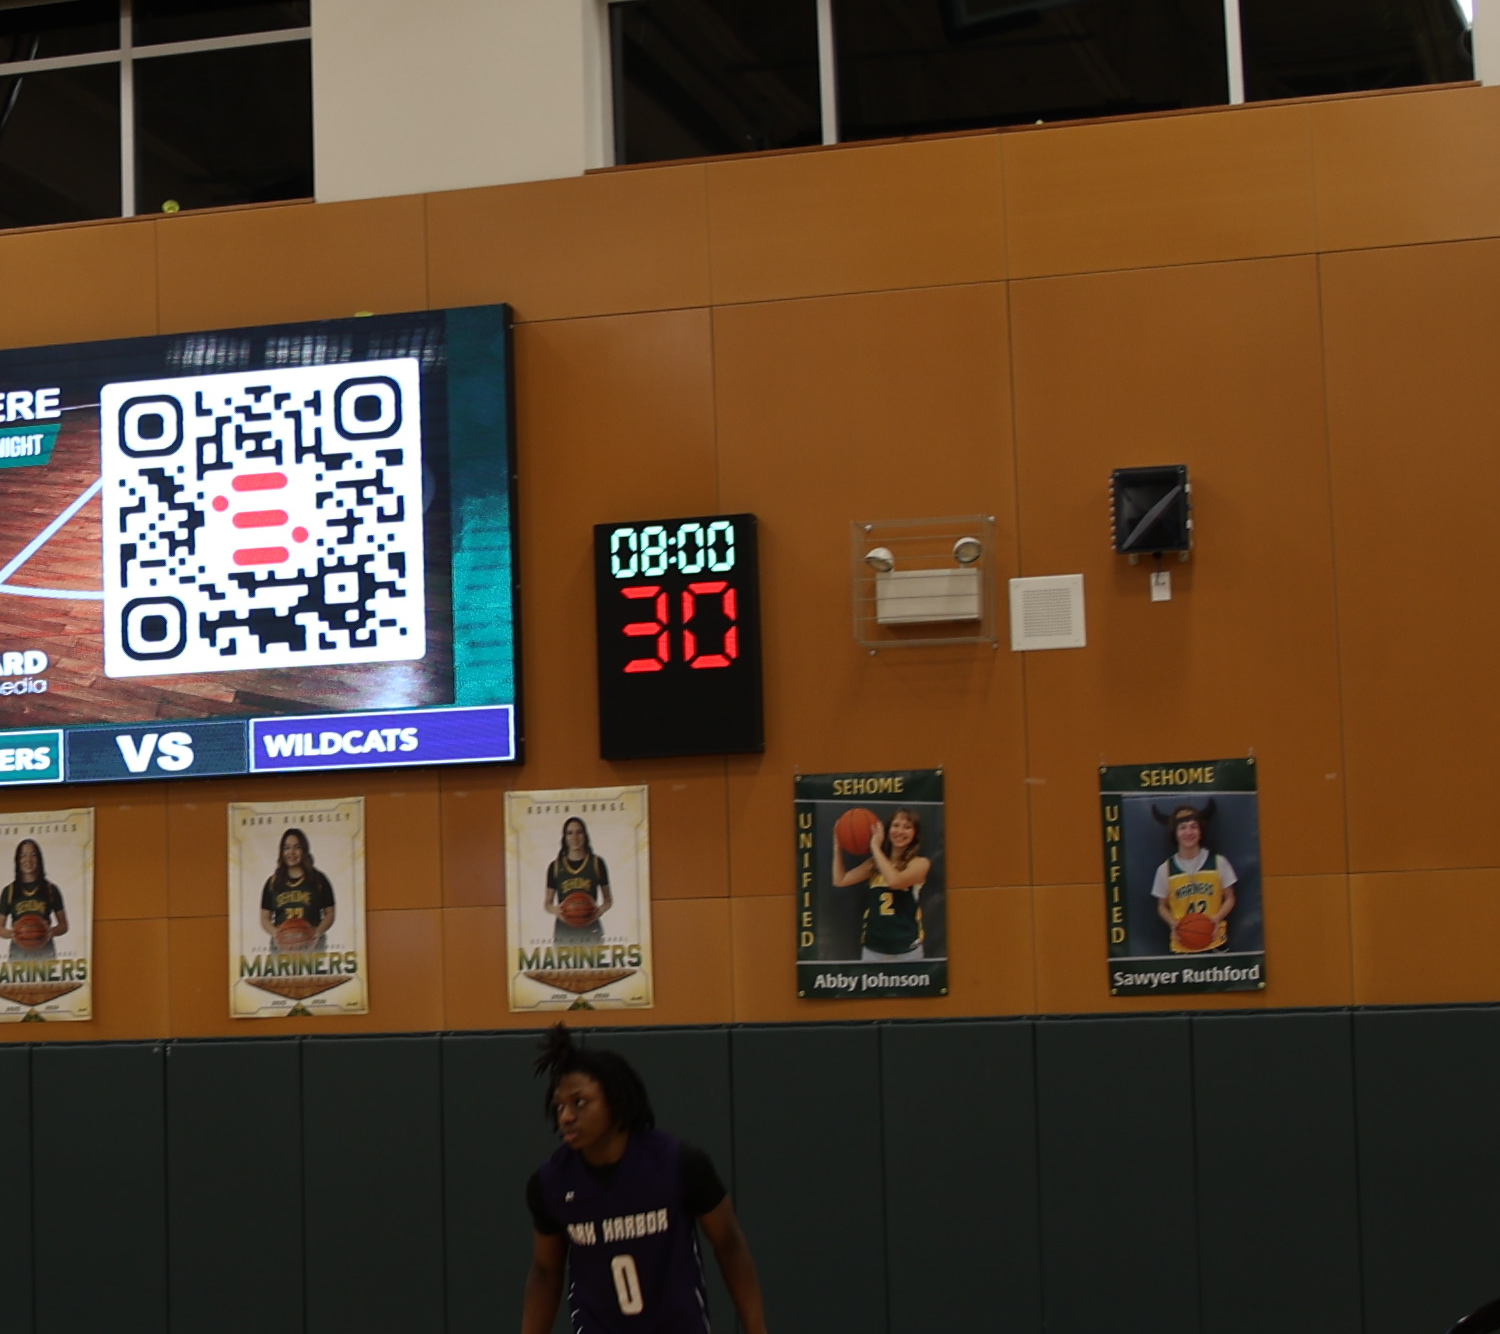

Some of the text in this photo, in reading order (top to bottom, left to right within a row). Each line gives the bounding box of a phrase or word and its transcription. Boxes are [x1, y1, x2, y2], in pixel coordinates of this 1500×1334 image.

[610, 520, 735, 579] 08:00
[620, 580, 739, 673] 30
[116, 731, 194, 773] VS
[263, 727, 419, 758] WILDCATS
[833, 776, 904, 796] SEHOME
[1140, 766, 1215, 788] SEHOME
[798, 812, 816, 948] UNIFIED
[1104, 805, 1127, 944] UNIFIED
[878, 892, 896, 916] 2
[240, 951, 358, 977] MARINERS
[519, 943, 642, 971] MARINERS
[814, 972, 931, 992] Abby Johnson
[1113, 964, 1260, 988] Sawyer Ruthford
[602, 1207, 669, 1244] HARBOR
[610, 1253, 645, 1317] 0
